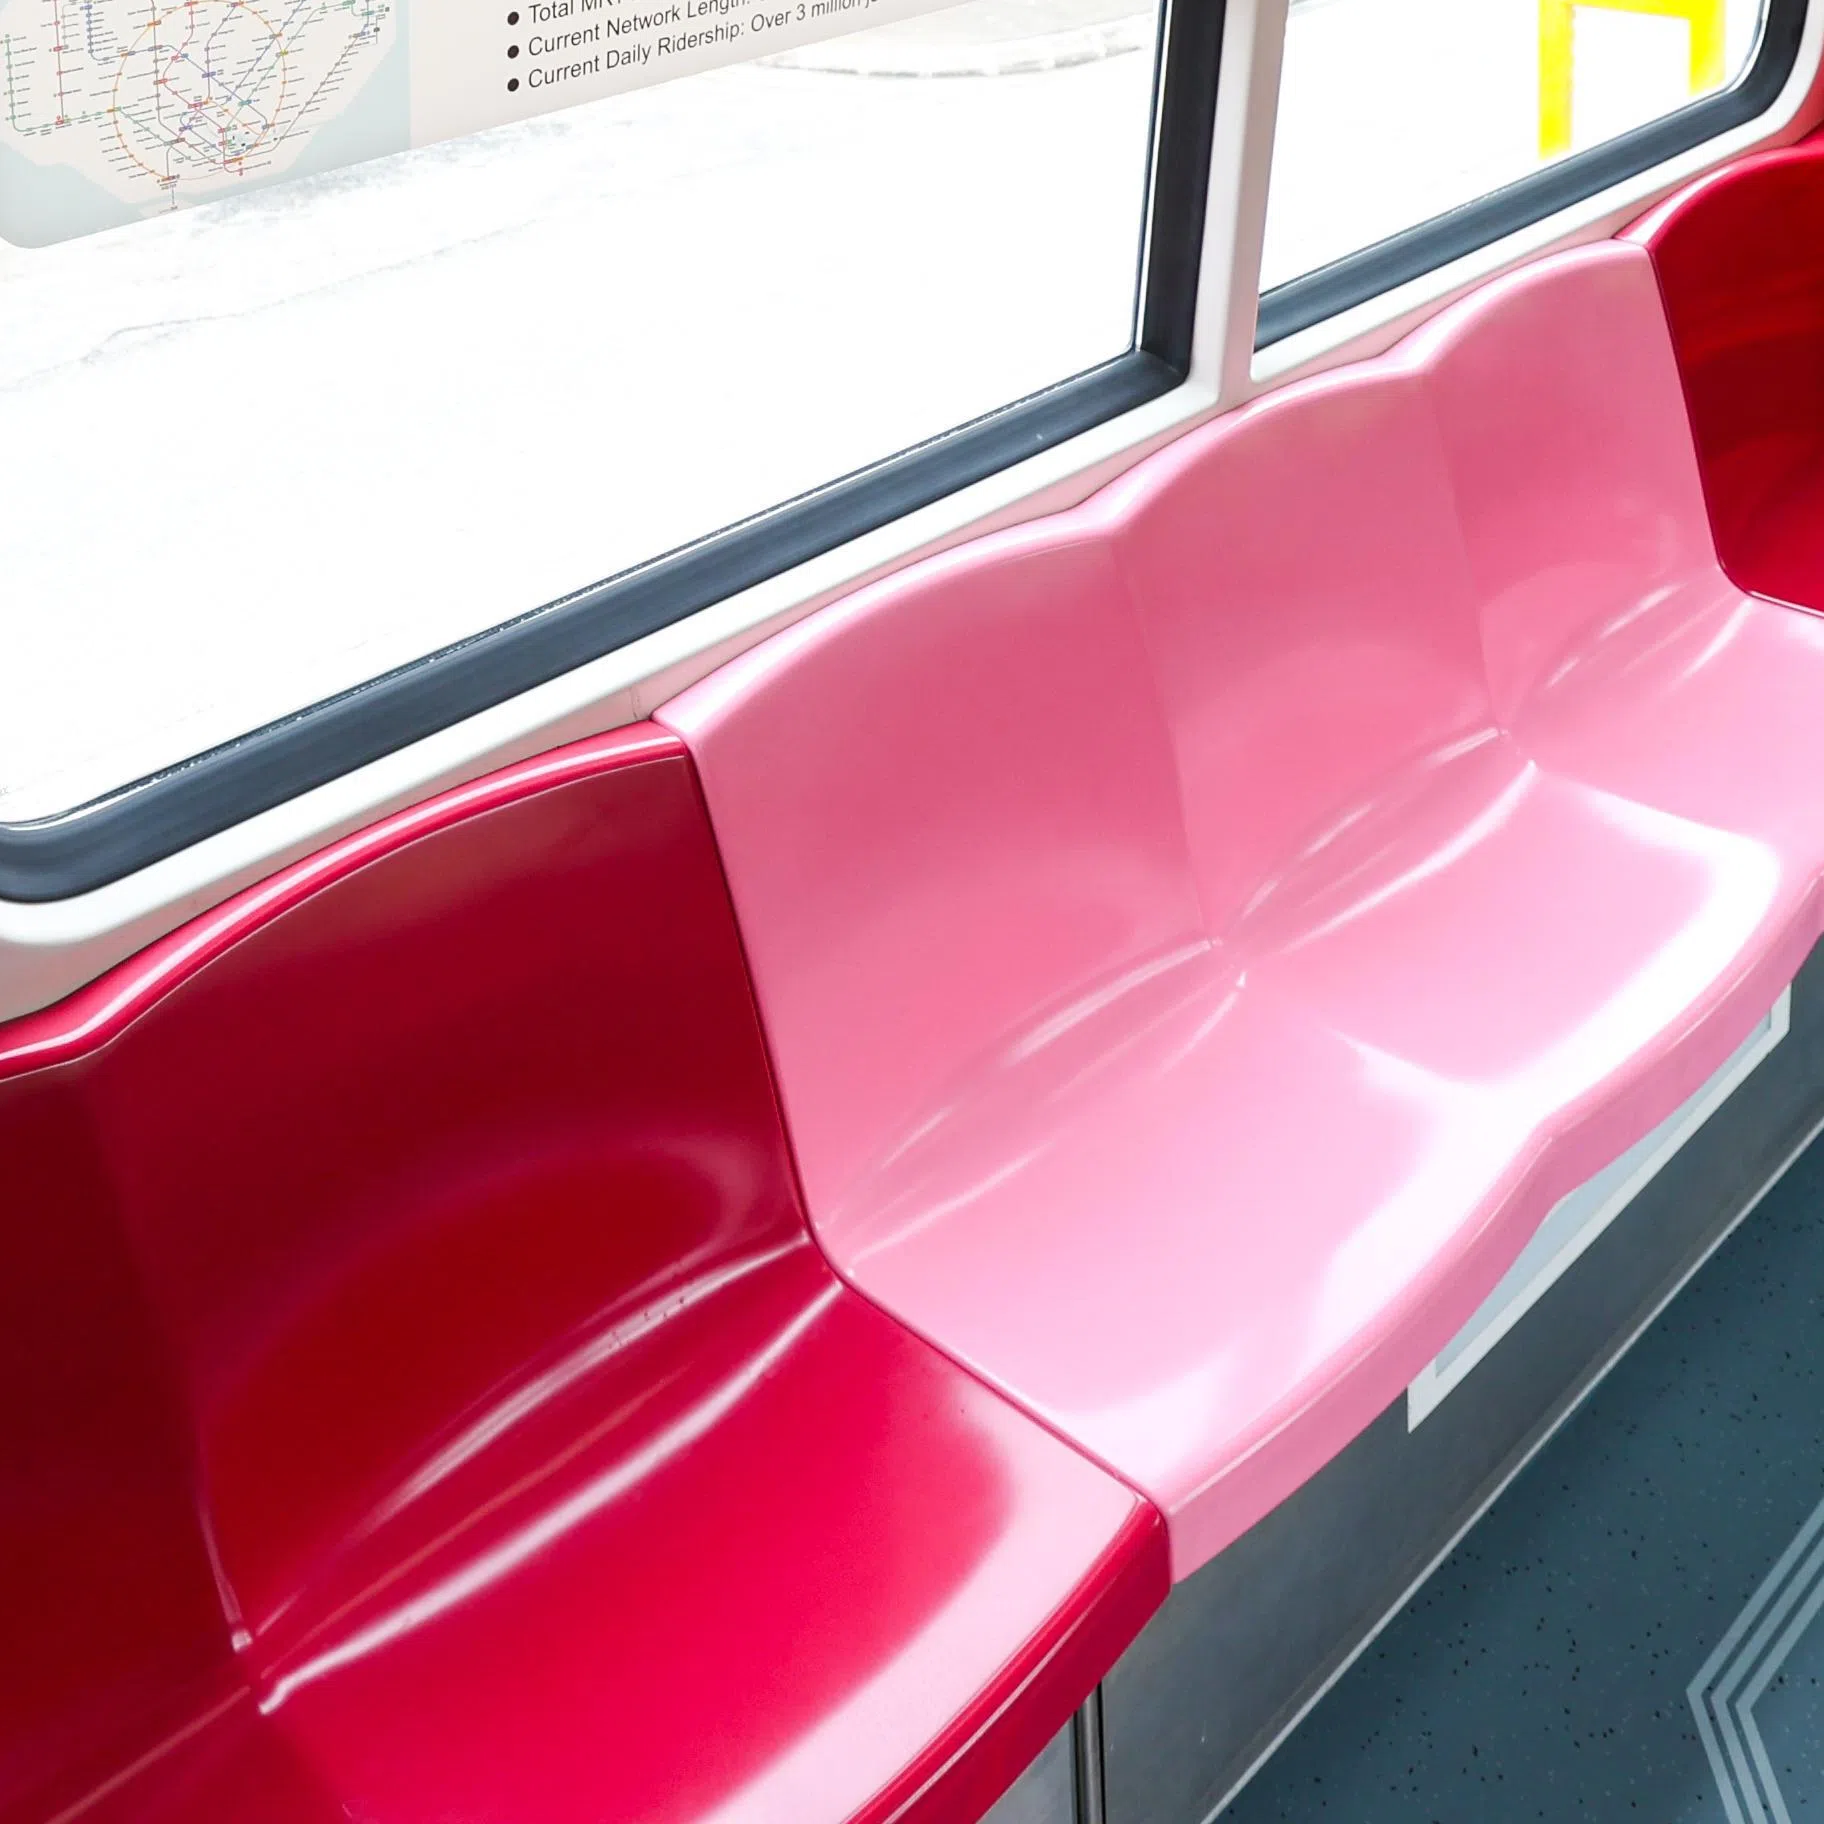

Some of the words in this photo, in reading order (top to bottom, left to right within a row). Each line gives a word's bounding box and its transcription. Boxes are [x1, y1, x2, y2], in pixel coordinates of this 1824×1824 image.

[528, 25, 601, 57] Current
[605, 4, 681, 38] Network
[528, 58, 601, 90] Current
[605, 41, 652, 71] Daily
[657, 21, 745, 58] Ridership:
[750, 9, 792, 33] Over
[796, 3, 806, 22] 3
